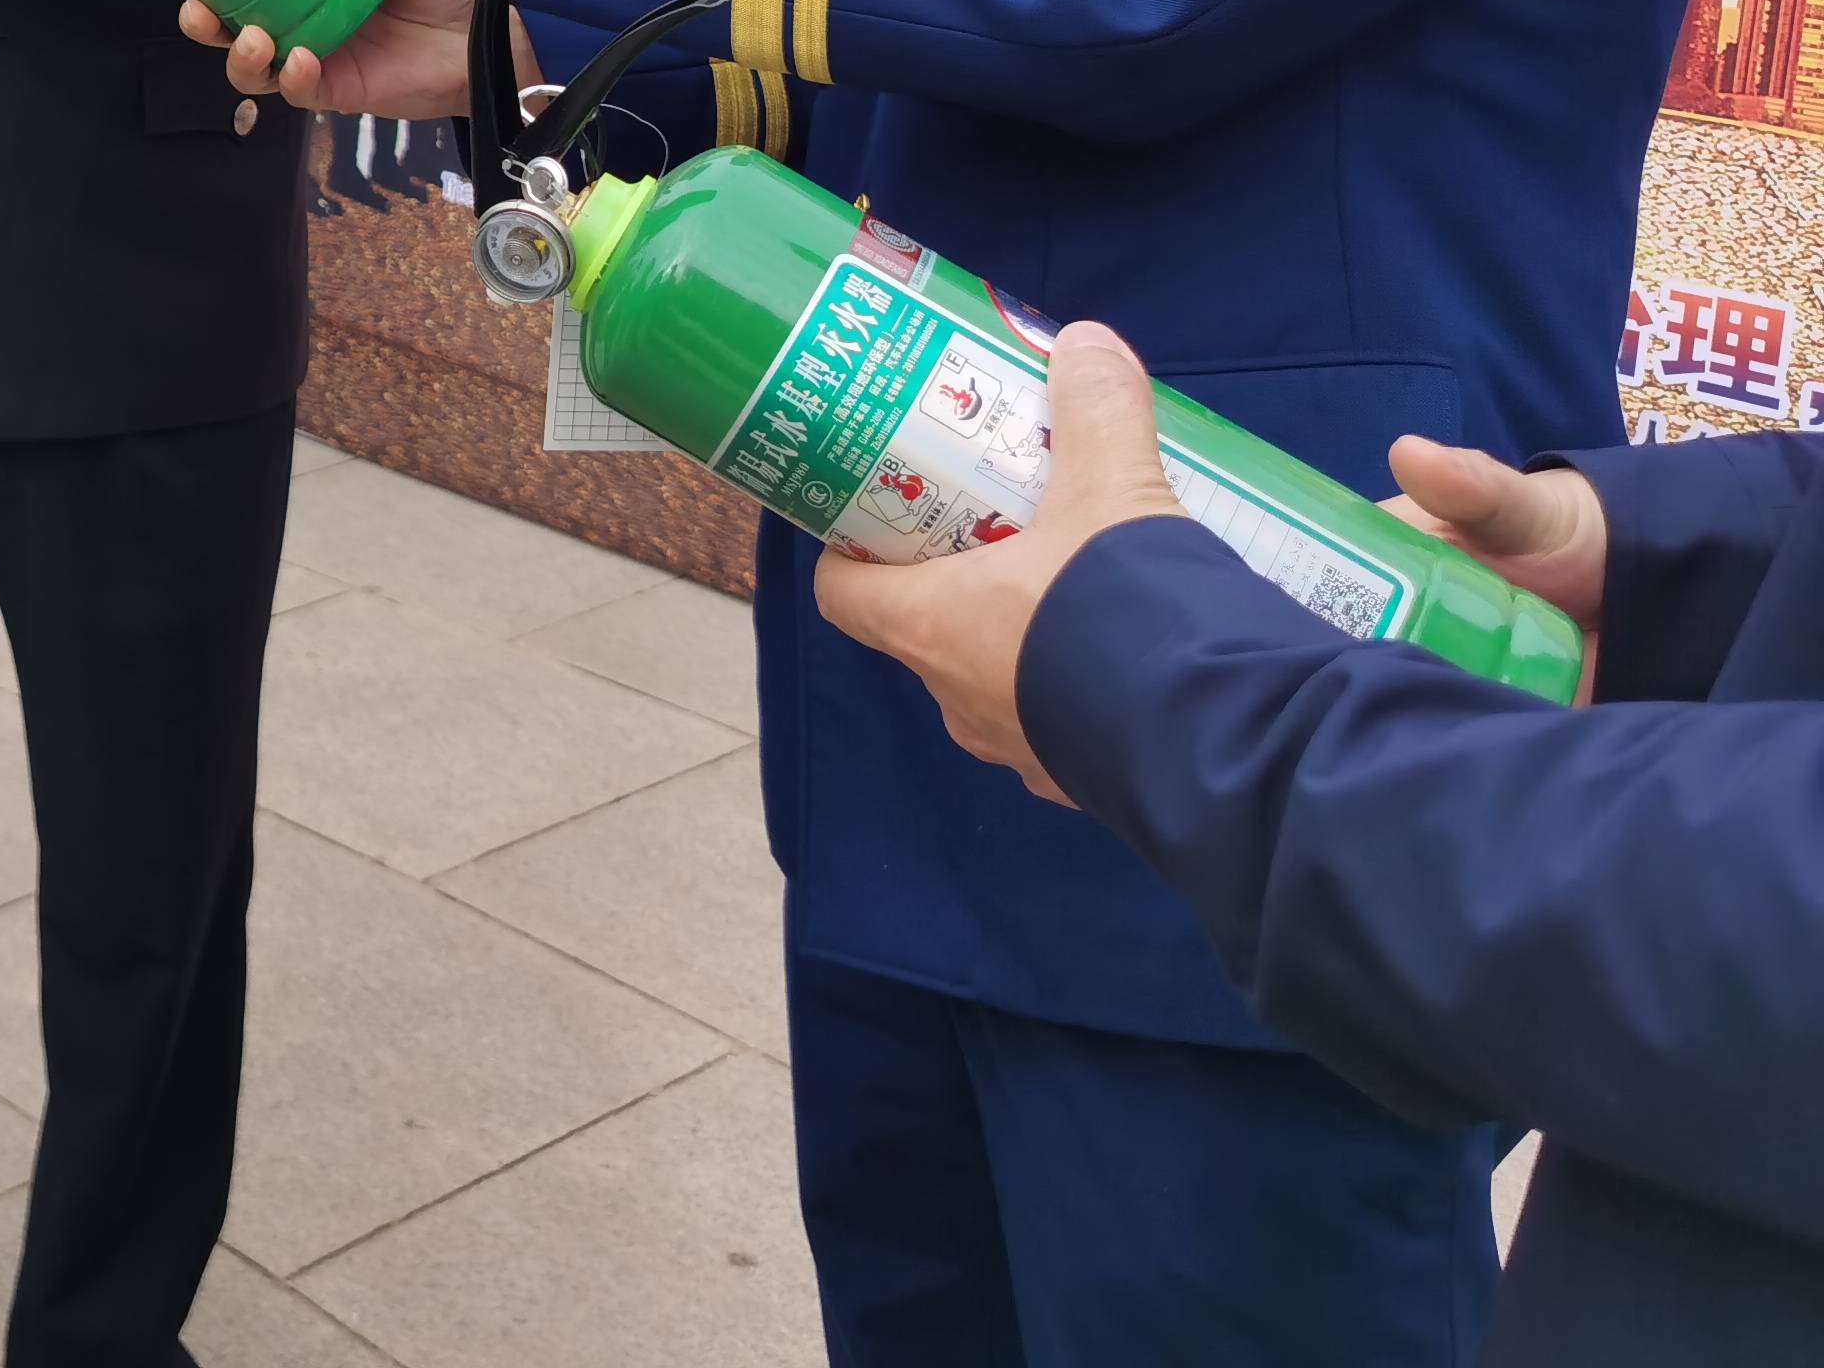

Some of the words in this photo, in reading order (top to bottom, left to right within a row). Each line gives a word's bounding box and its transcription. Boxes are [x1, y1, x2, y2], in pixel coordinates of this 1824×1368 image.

[946, 353, 961, 367] F
[725, 272, 894, 498] 简易式水基型灭火器
[885, 456, 900, 473] B
[981, 456, 994, 468] 3
[918, 550, 931, 561] 2
